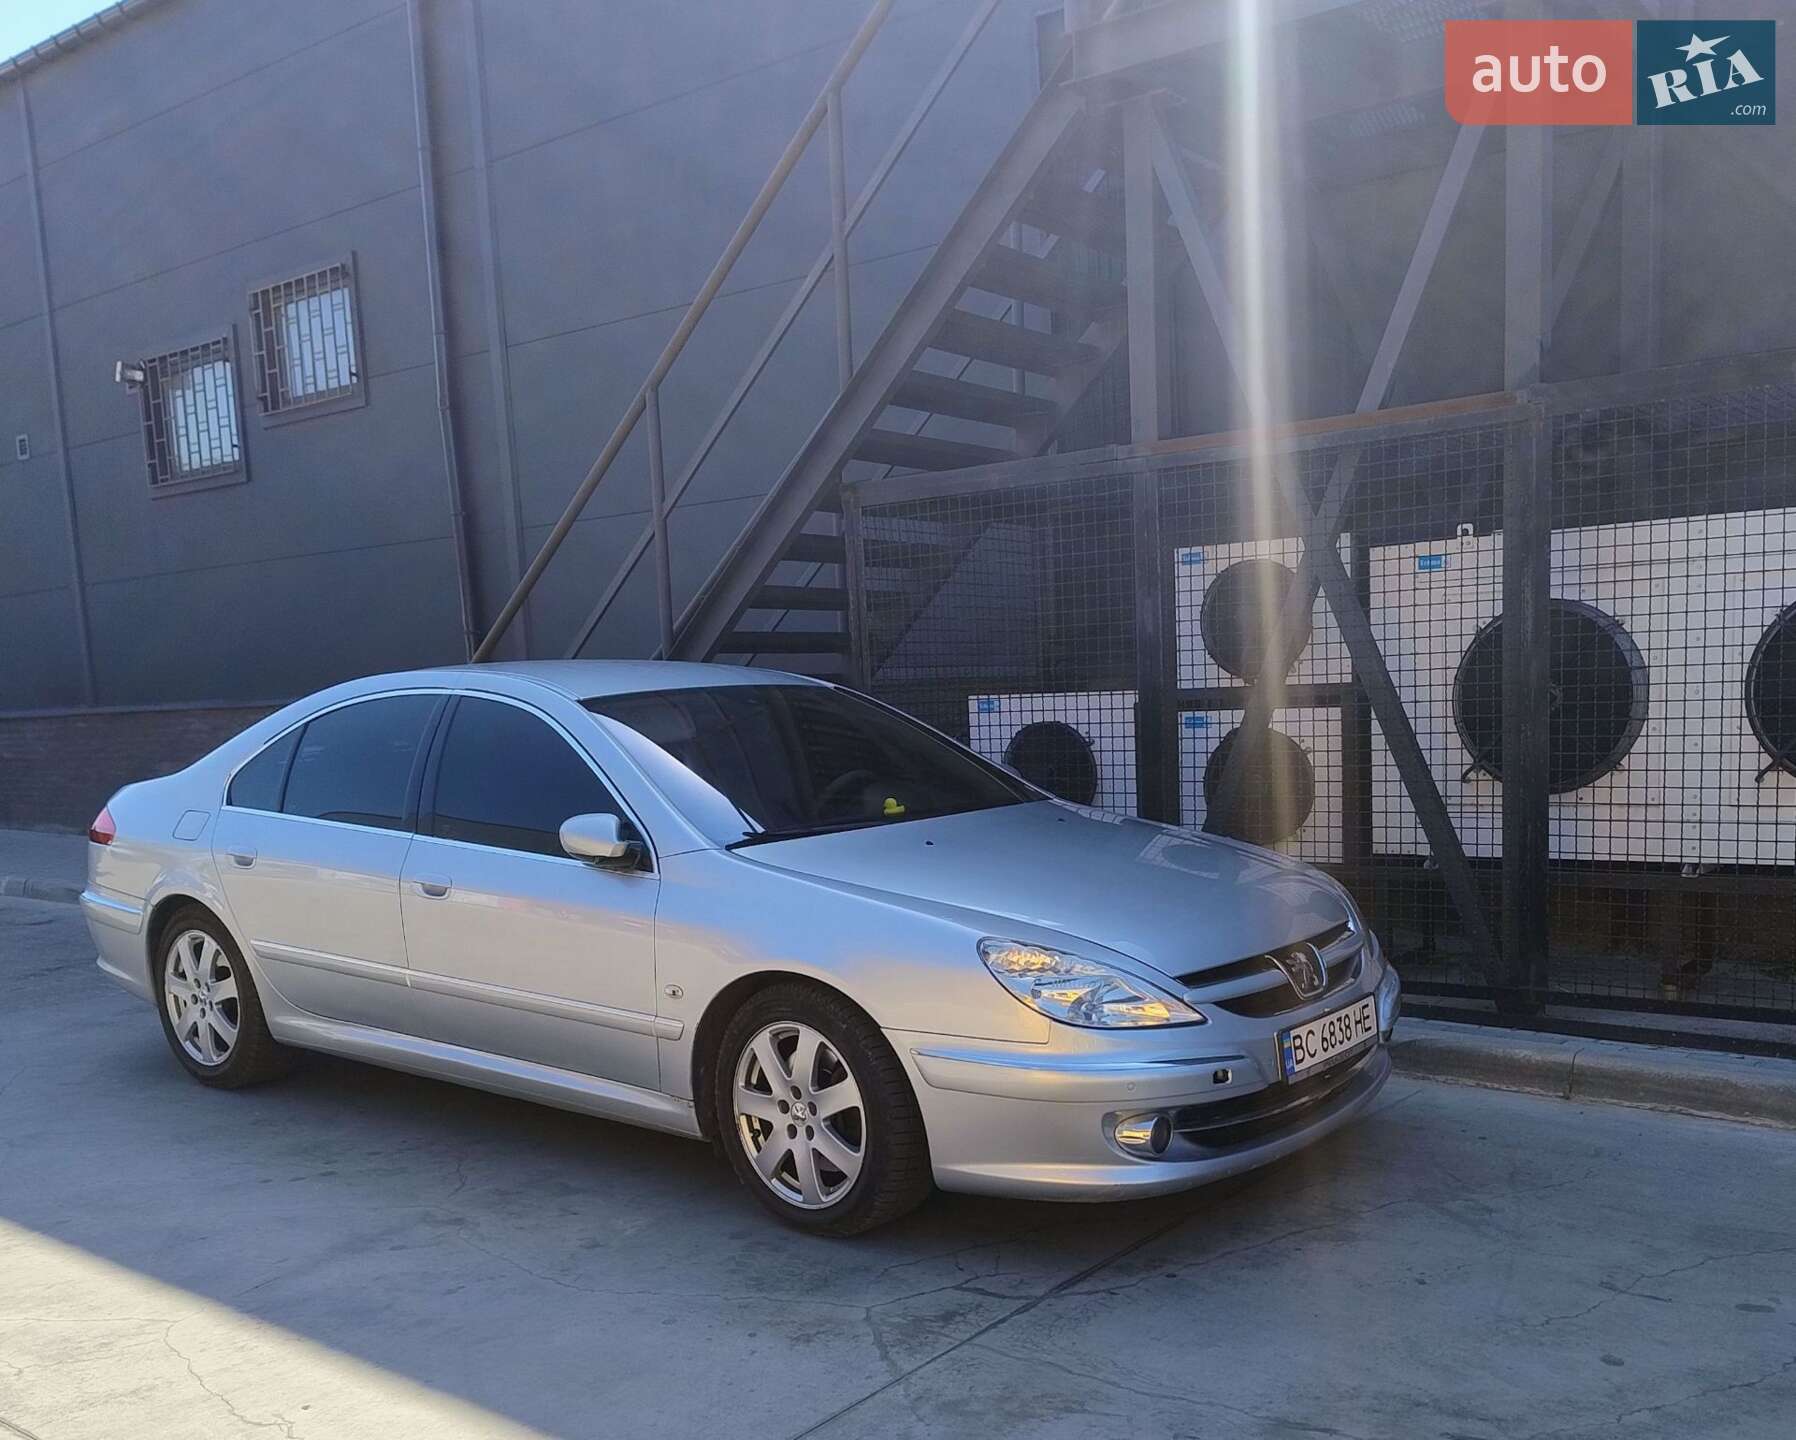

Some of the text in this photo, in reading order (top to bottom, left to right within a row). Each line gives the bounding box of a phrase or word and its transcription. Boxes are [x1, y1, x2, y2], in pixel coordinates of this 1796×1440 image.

[1293, 1029, 1318, 1066] BC
[1321, 1014, 1352, 1053] 6838
[1353, 1004, 1372, 1038] HE
